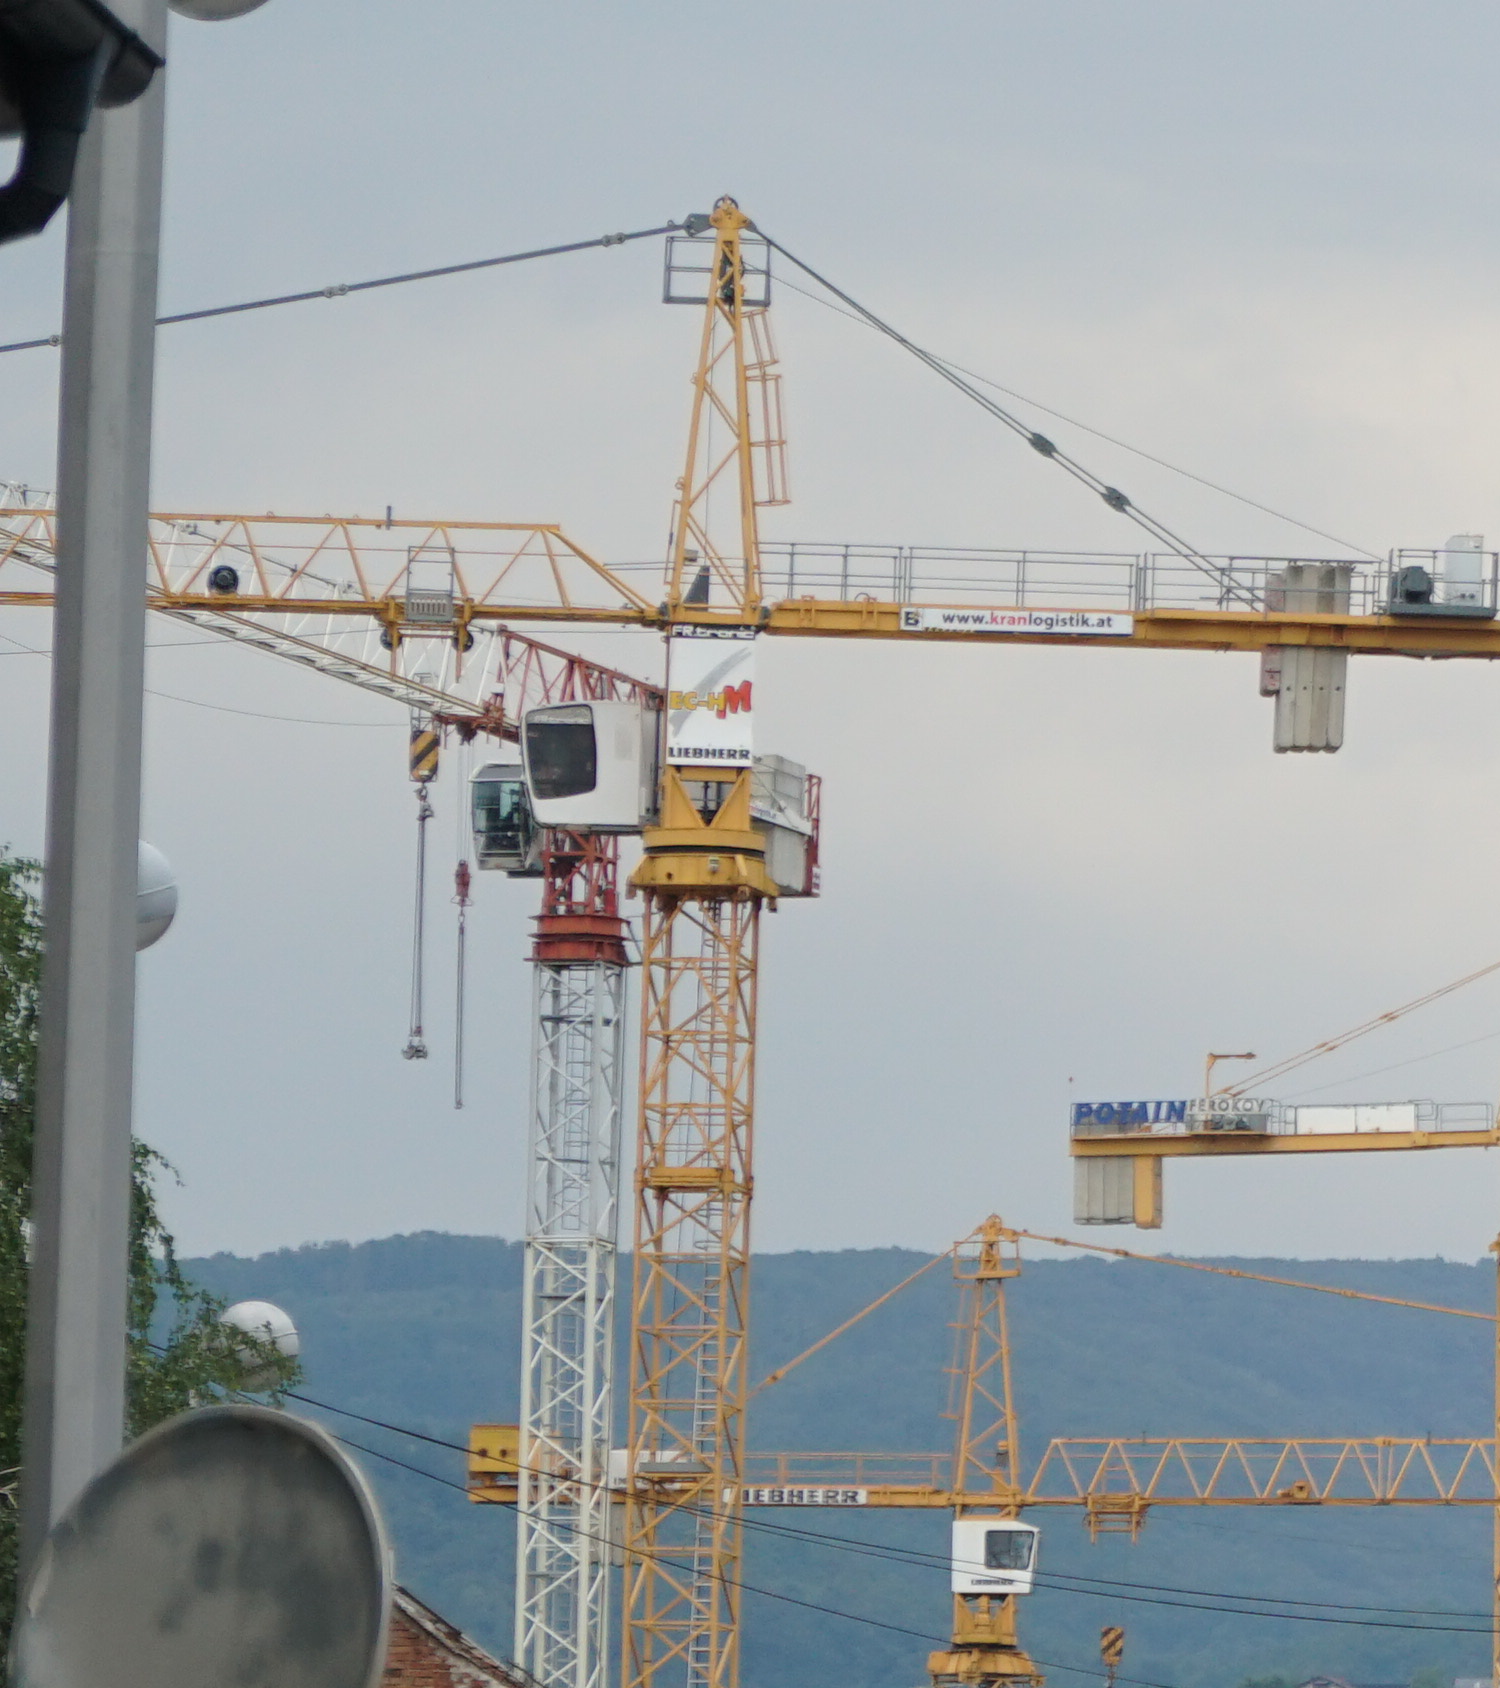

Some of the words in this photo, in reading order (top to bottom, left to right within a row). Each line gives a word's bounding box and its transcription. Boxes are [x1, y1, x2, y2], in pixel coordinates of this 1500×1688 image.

[942, 610, 1113, 629] www.kranlogistik.at
[668, 746, 751, 760] LIEBHERR
[1074, 1101, 1187, 1124] POTAIN
[740, 1489, 860, 1504] IEBHERR
